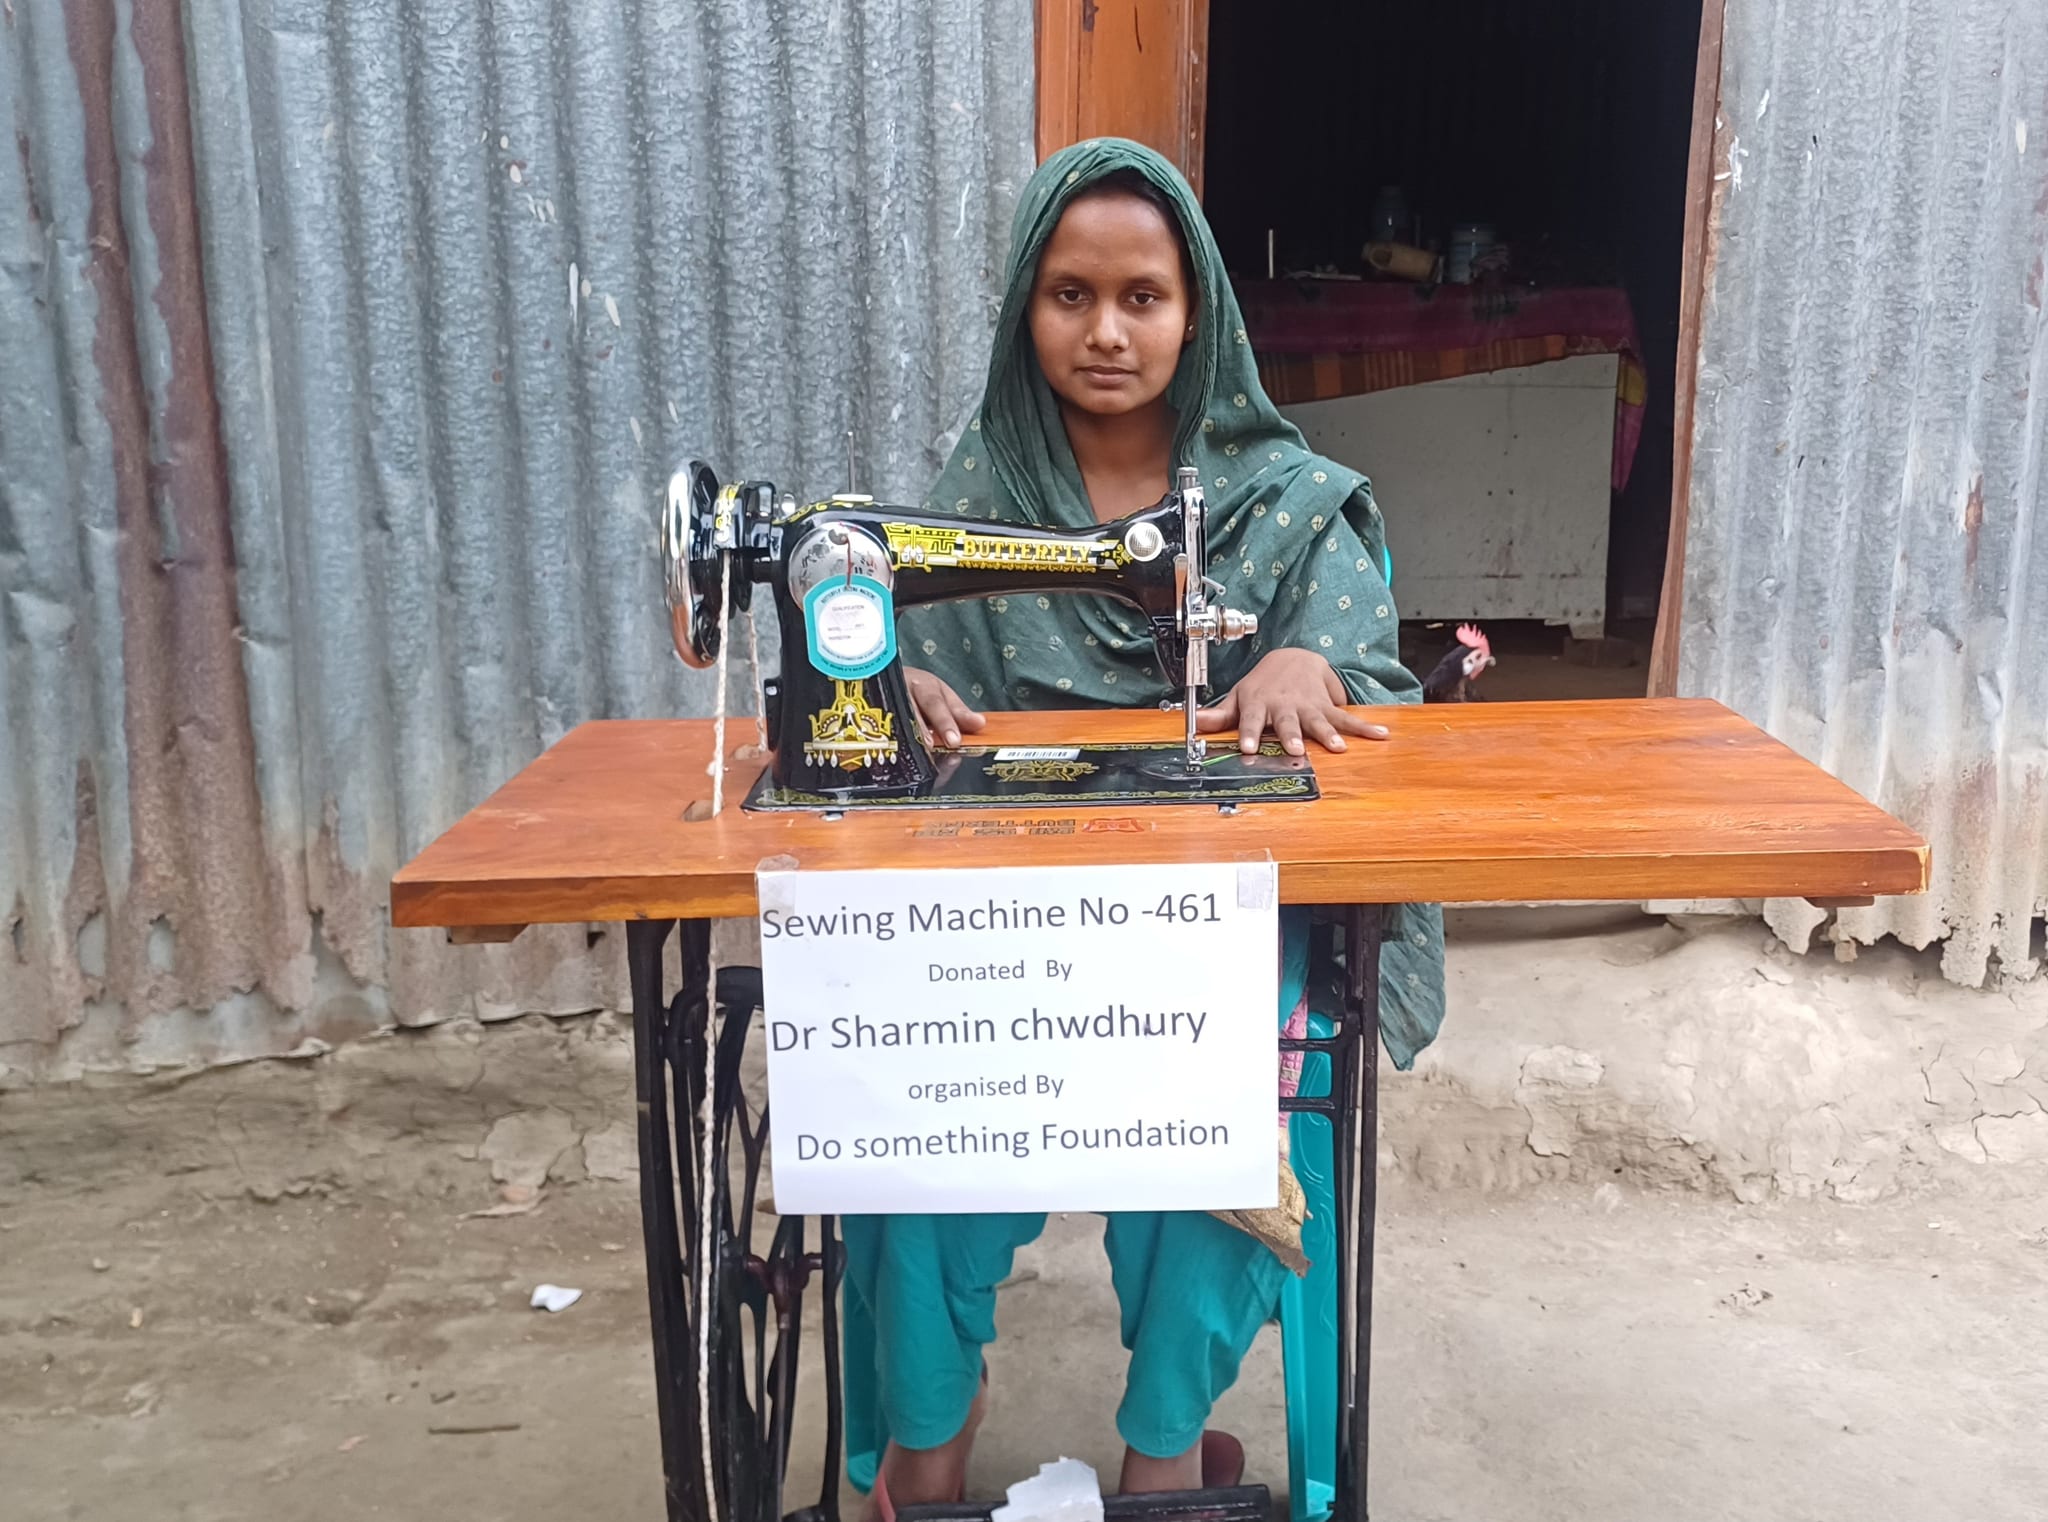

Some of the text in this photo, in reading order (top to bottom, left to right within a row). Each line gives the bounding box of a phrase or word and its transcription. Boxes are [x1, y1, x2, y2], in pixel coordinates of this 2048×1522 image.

[963, 538, 1092, 564] BUTTERFLY
[762, 892, 1222, 941] Sewing Machine No -461
[928, 959, 1073, 983] Donated By
[772, 1004, 1207, 1052] Dr Sharmin chwdhury
[908, 1073, 1065, 1104] organised By
[797, 1119, 1229, 1161] Do something Foundation
